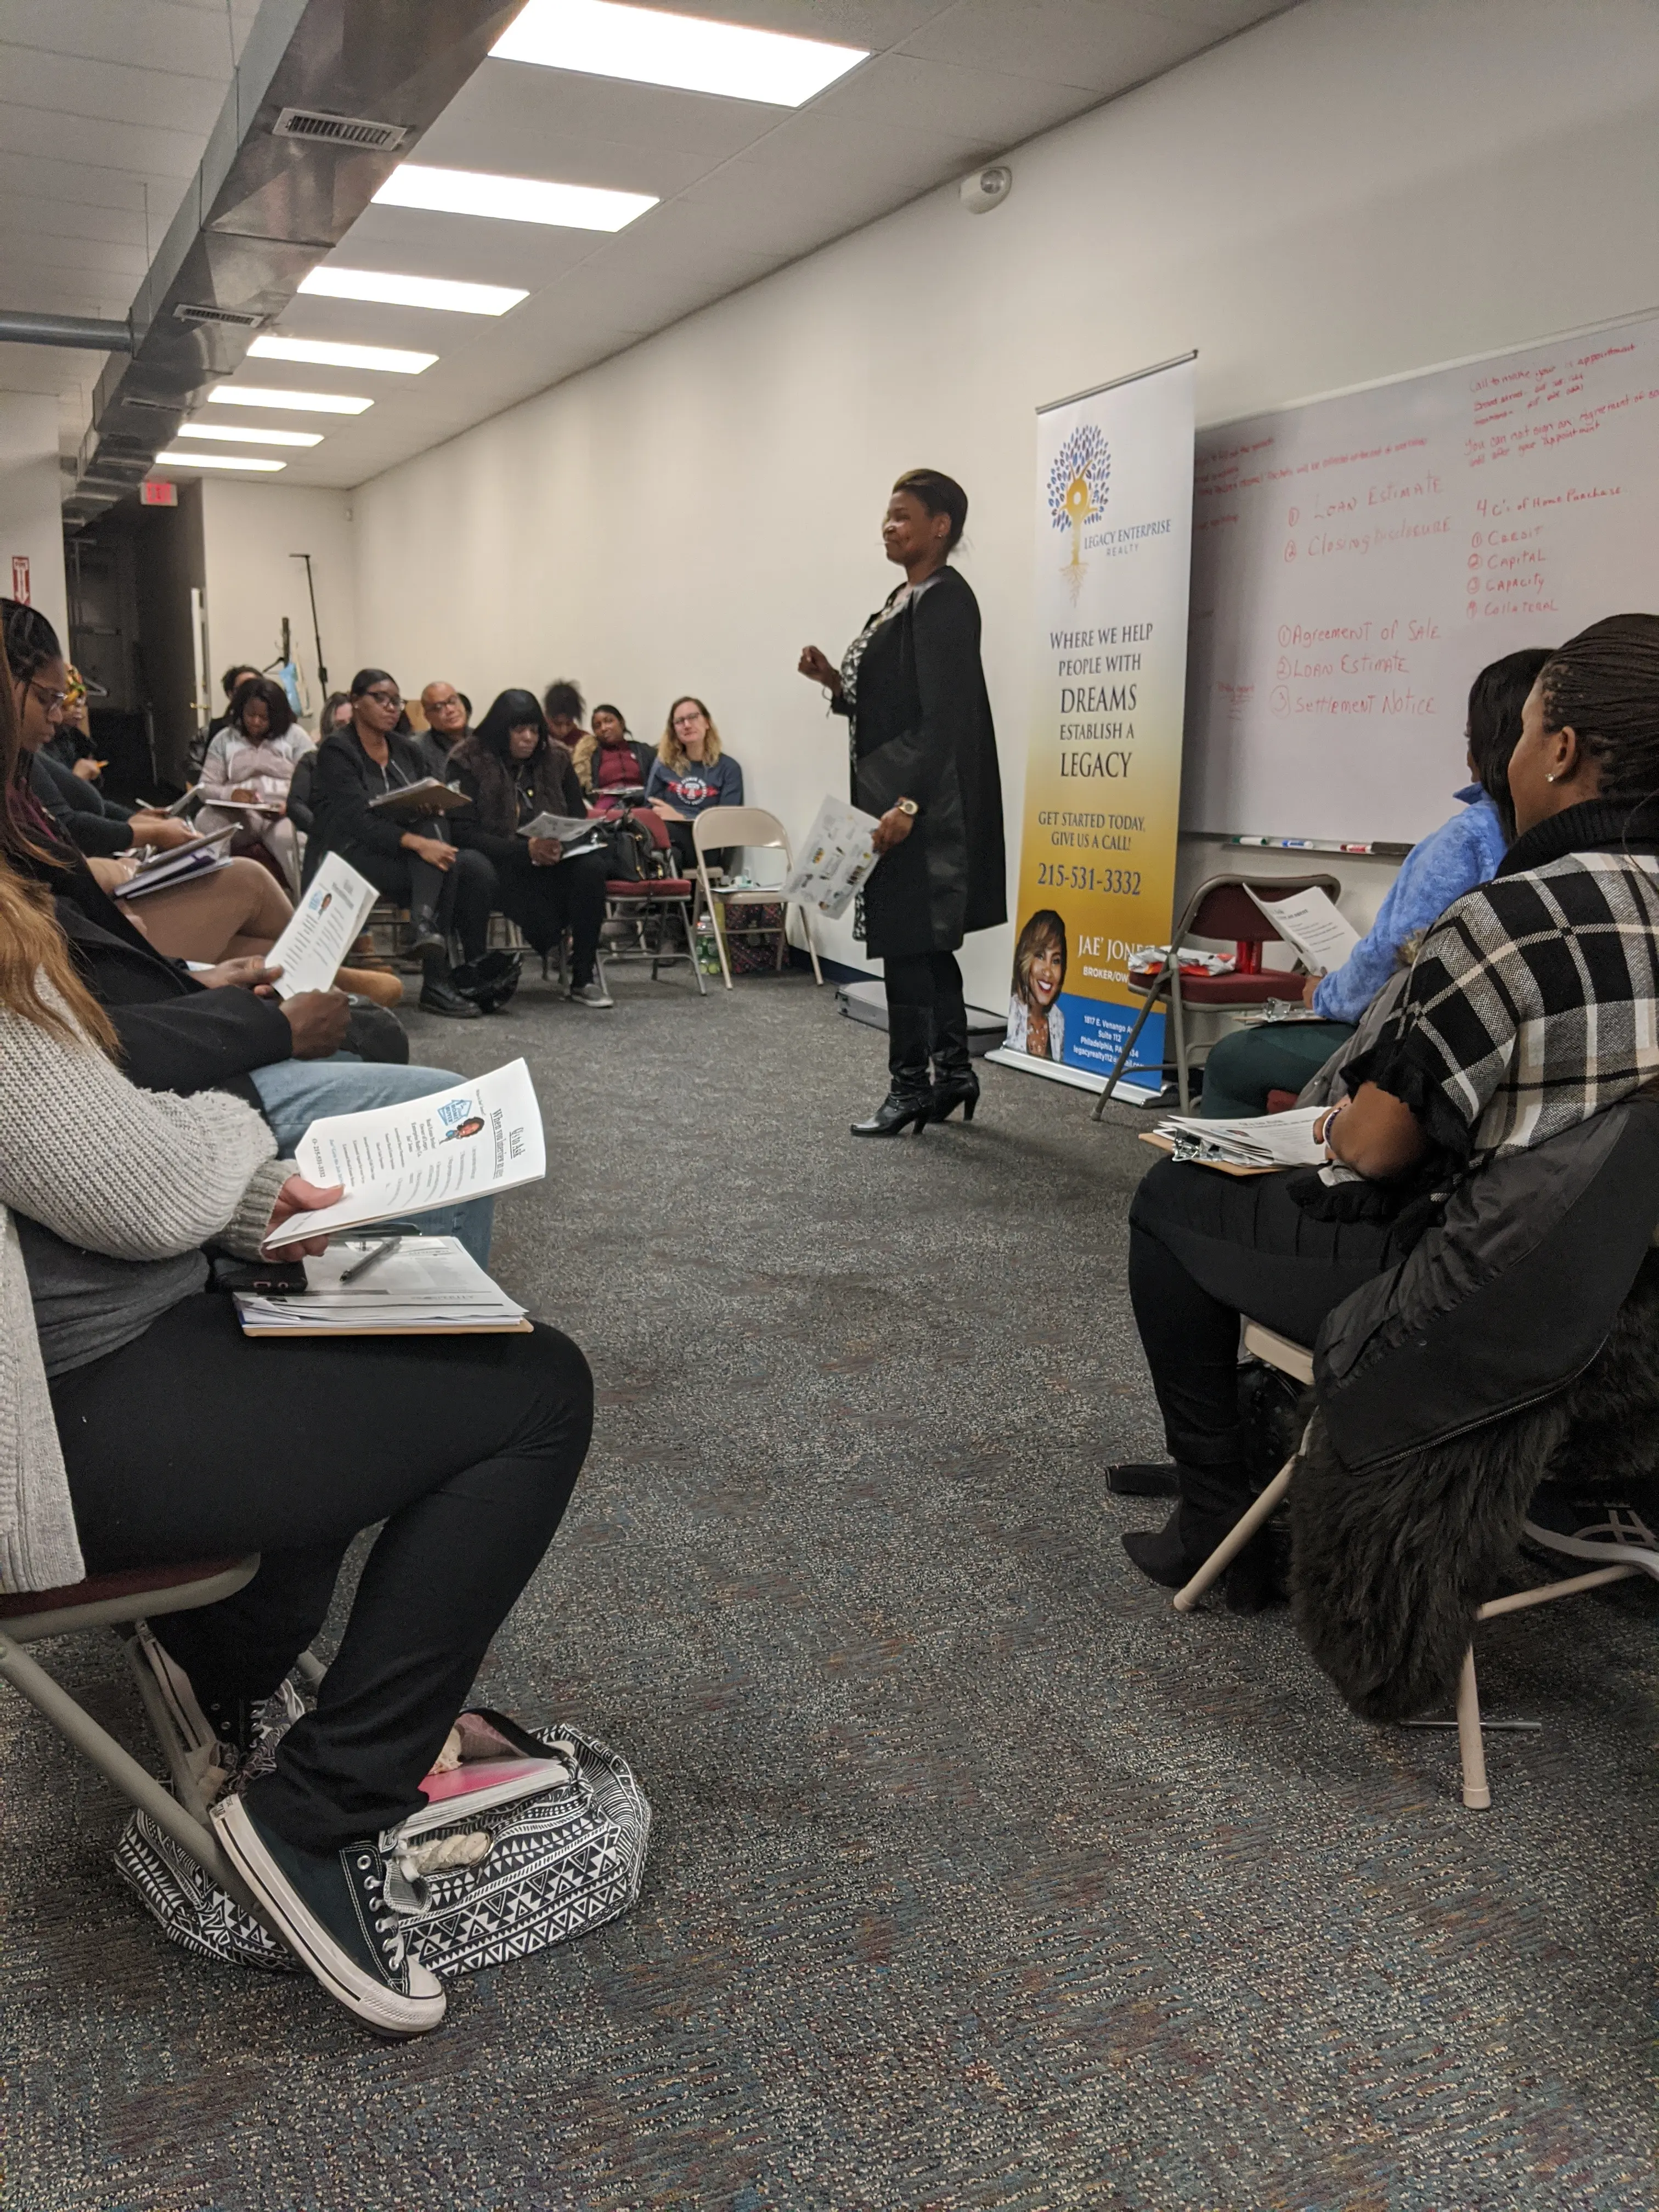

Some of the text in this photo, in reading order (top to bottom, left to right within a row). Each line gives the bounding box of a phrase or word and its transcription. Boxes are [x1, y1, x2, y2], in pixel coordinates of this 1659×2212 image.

[1476, 499, 1487, 517] 4
[1517, 496, 1530, 510] of
[1084, 520, 1171, 549] LEGACY ENTERPRISE
[1107, 544, 1138, 556] REALTY
[1049, 623, 1153, 650] WHERE WE HELP
[1058, 653, 1142, 676] PEOPLE WITH
[1060, 684, 1137, 713] DREAMS
[1060, 723, 1135, 740] ESTABLISH A
[1060, 752, 1132, 778] LEGACY
[1039, 811, 1059, 825] GET
[1062, 812, 1105, 828] STARTED
[1051, 831, 1131, 850] GIVE US A CALL!
[1037, 862, 1141, 896] 215-531-3332
[1083, 965, 1128, 983] BROKER/OW
[1098, 1030, 1112, 1040] Suite
[1102, 1020, 1126, 1032] Venango
[493, 1109, 503, 1130] When
